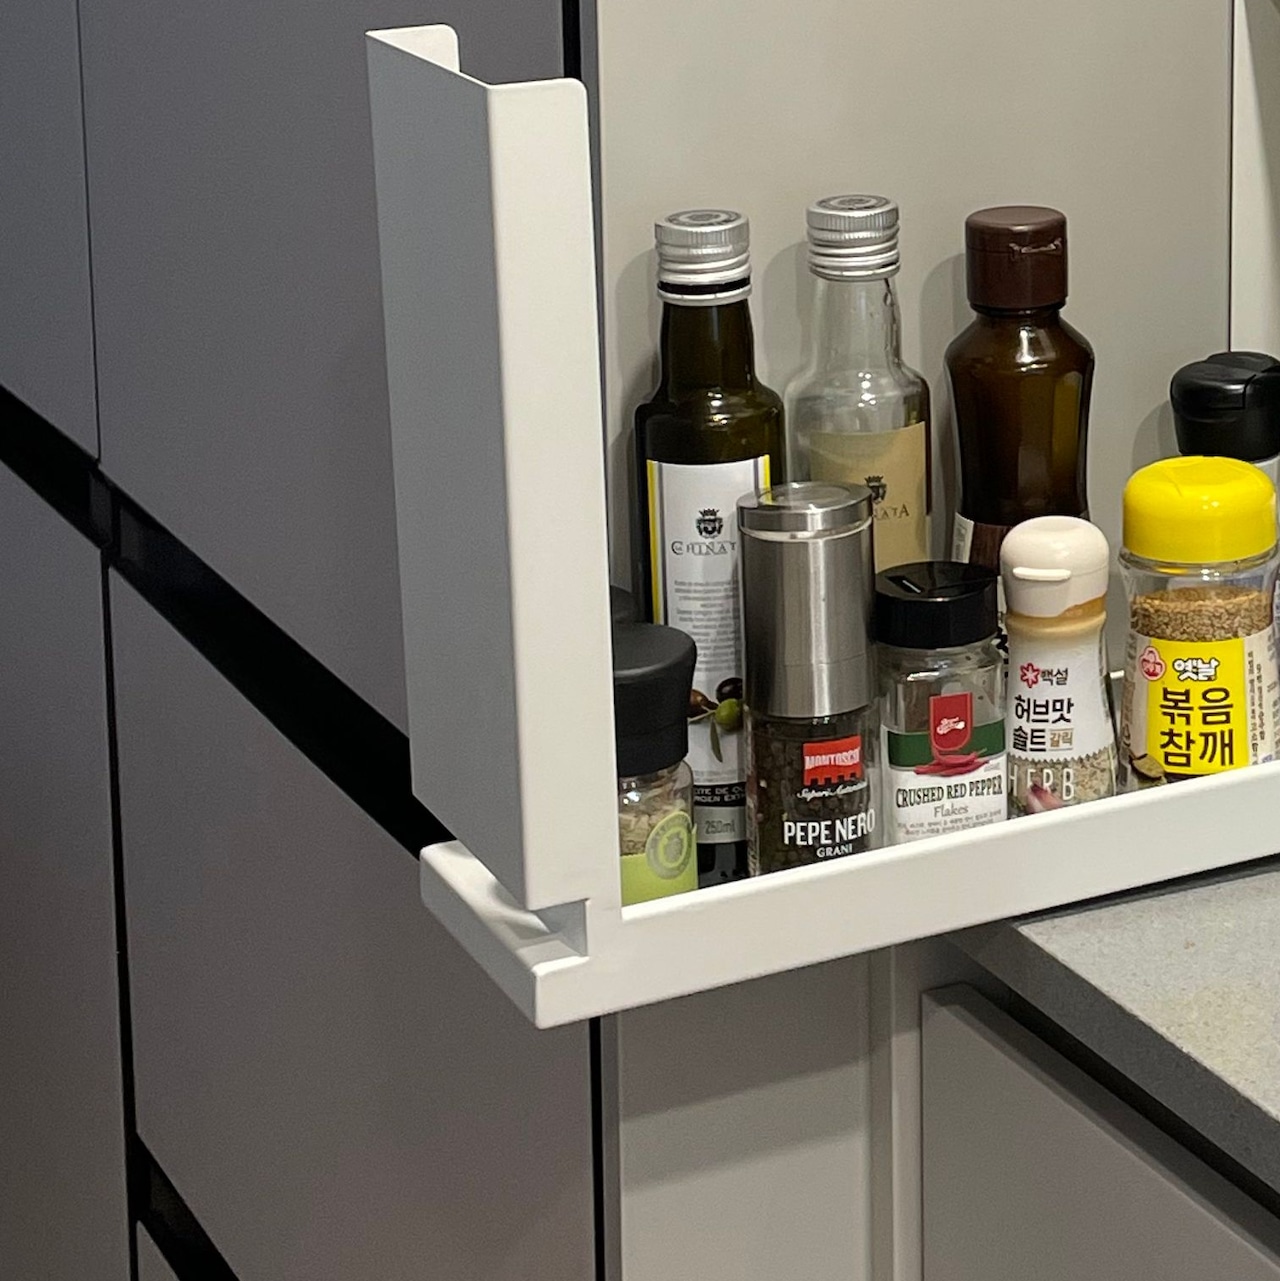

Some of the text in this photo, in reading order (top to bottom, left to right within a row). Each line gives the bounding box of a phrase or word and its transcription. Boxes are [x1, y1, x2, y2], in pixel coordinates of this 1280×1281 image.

[671, 540, 737, 556] CHINAT
[1041, 667, 1069, 686] 백설
[1172, 657, 1220, 681] 옛날
[1014, 694, 1075, 724] 허브맛
[1159, 687, 1234, 726] 볶음
[1012, 725, 1074, 753] 솔트 갈릭
[1159, 728, 1234, 767] 참깨
[895, 774, 1003, 808] CRUSHED RED PEPPER
[933, 803, 969, 818] Flakes
[783, 819, 832, 846] PEPE
[835, 808, 876, 844] NERO
[816, 843, 853, 858] GRANI
